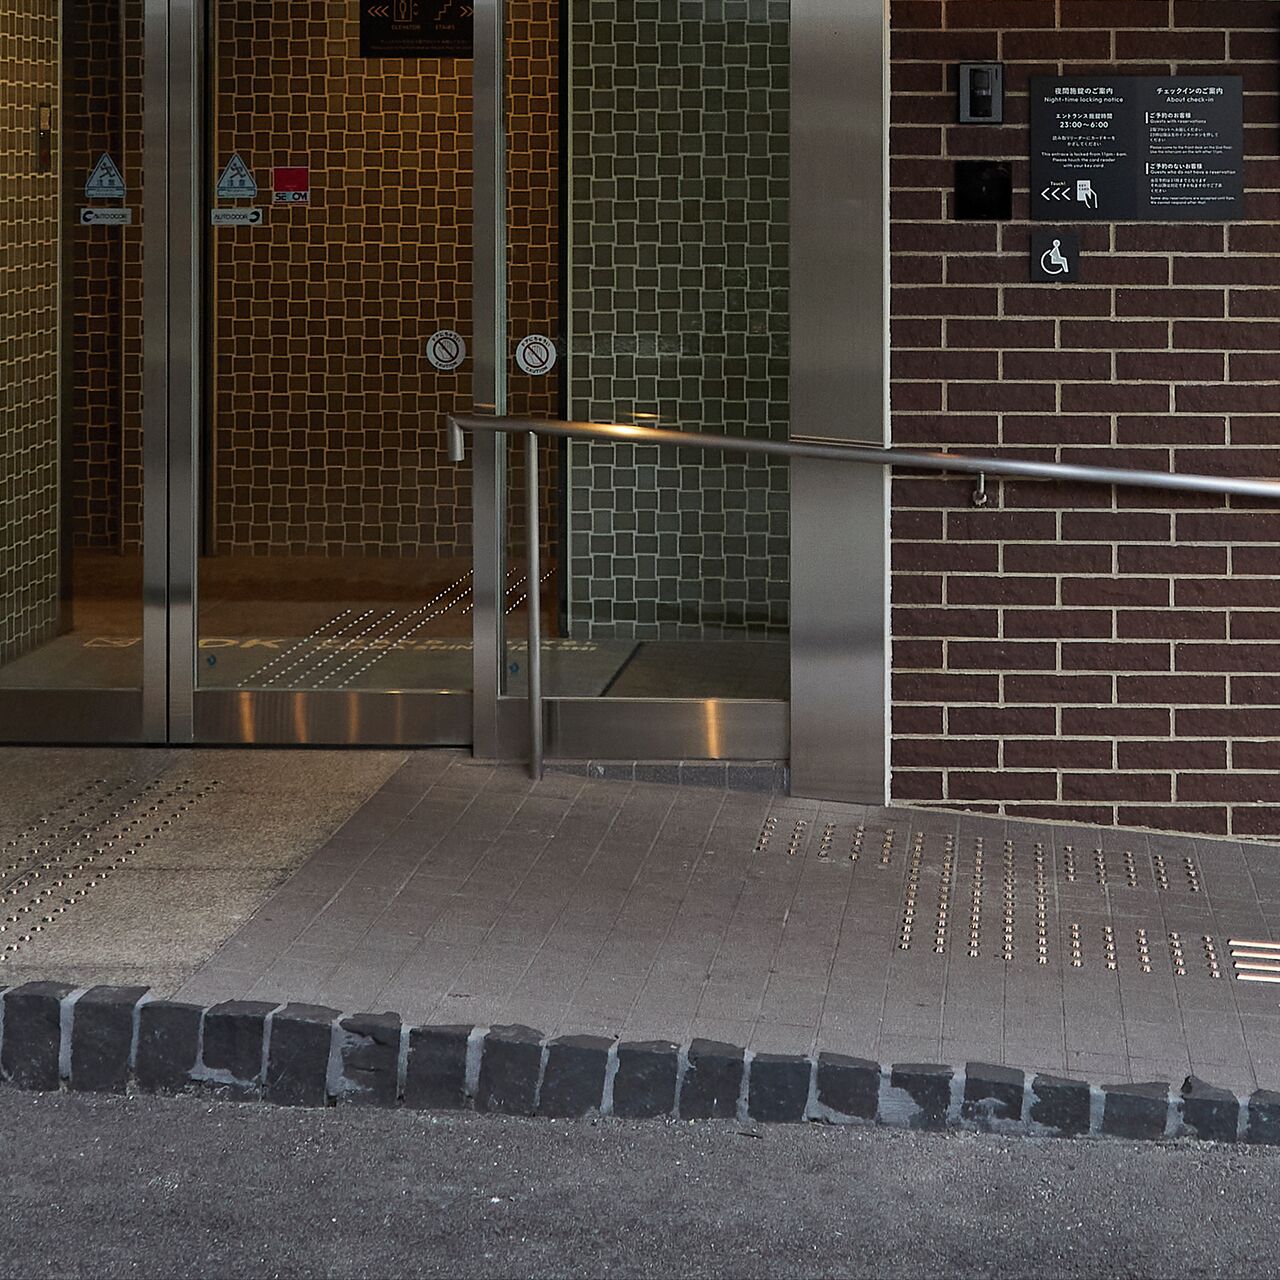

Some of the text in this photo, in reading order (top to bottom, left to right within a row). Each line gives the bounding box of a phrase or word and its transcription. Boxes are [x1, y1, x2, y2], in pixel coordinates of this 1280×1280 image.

[1054, 87, 1113, 95] 夜間施錠のご案内
[1156, 87, 1223, 95] チェックインのご案内
[275, 192, 307, 201] SECOM
[198, 638, 286, 649] DK
